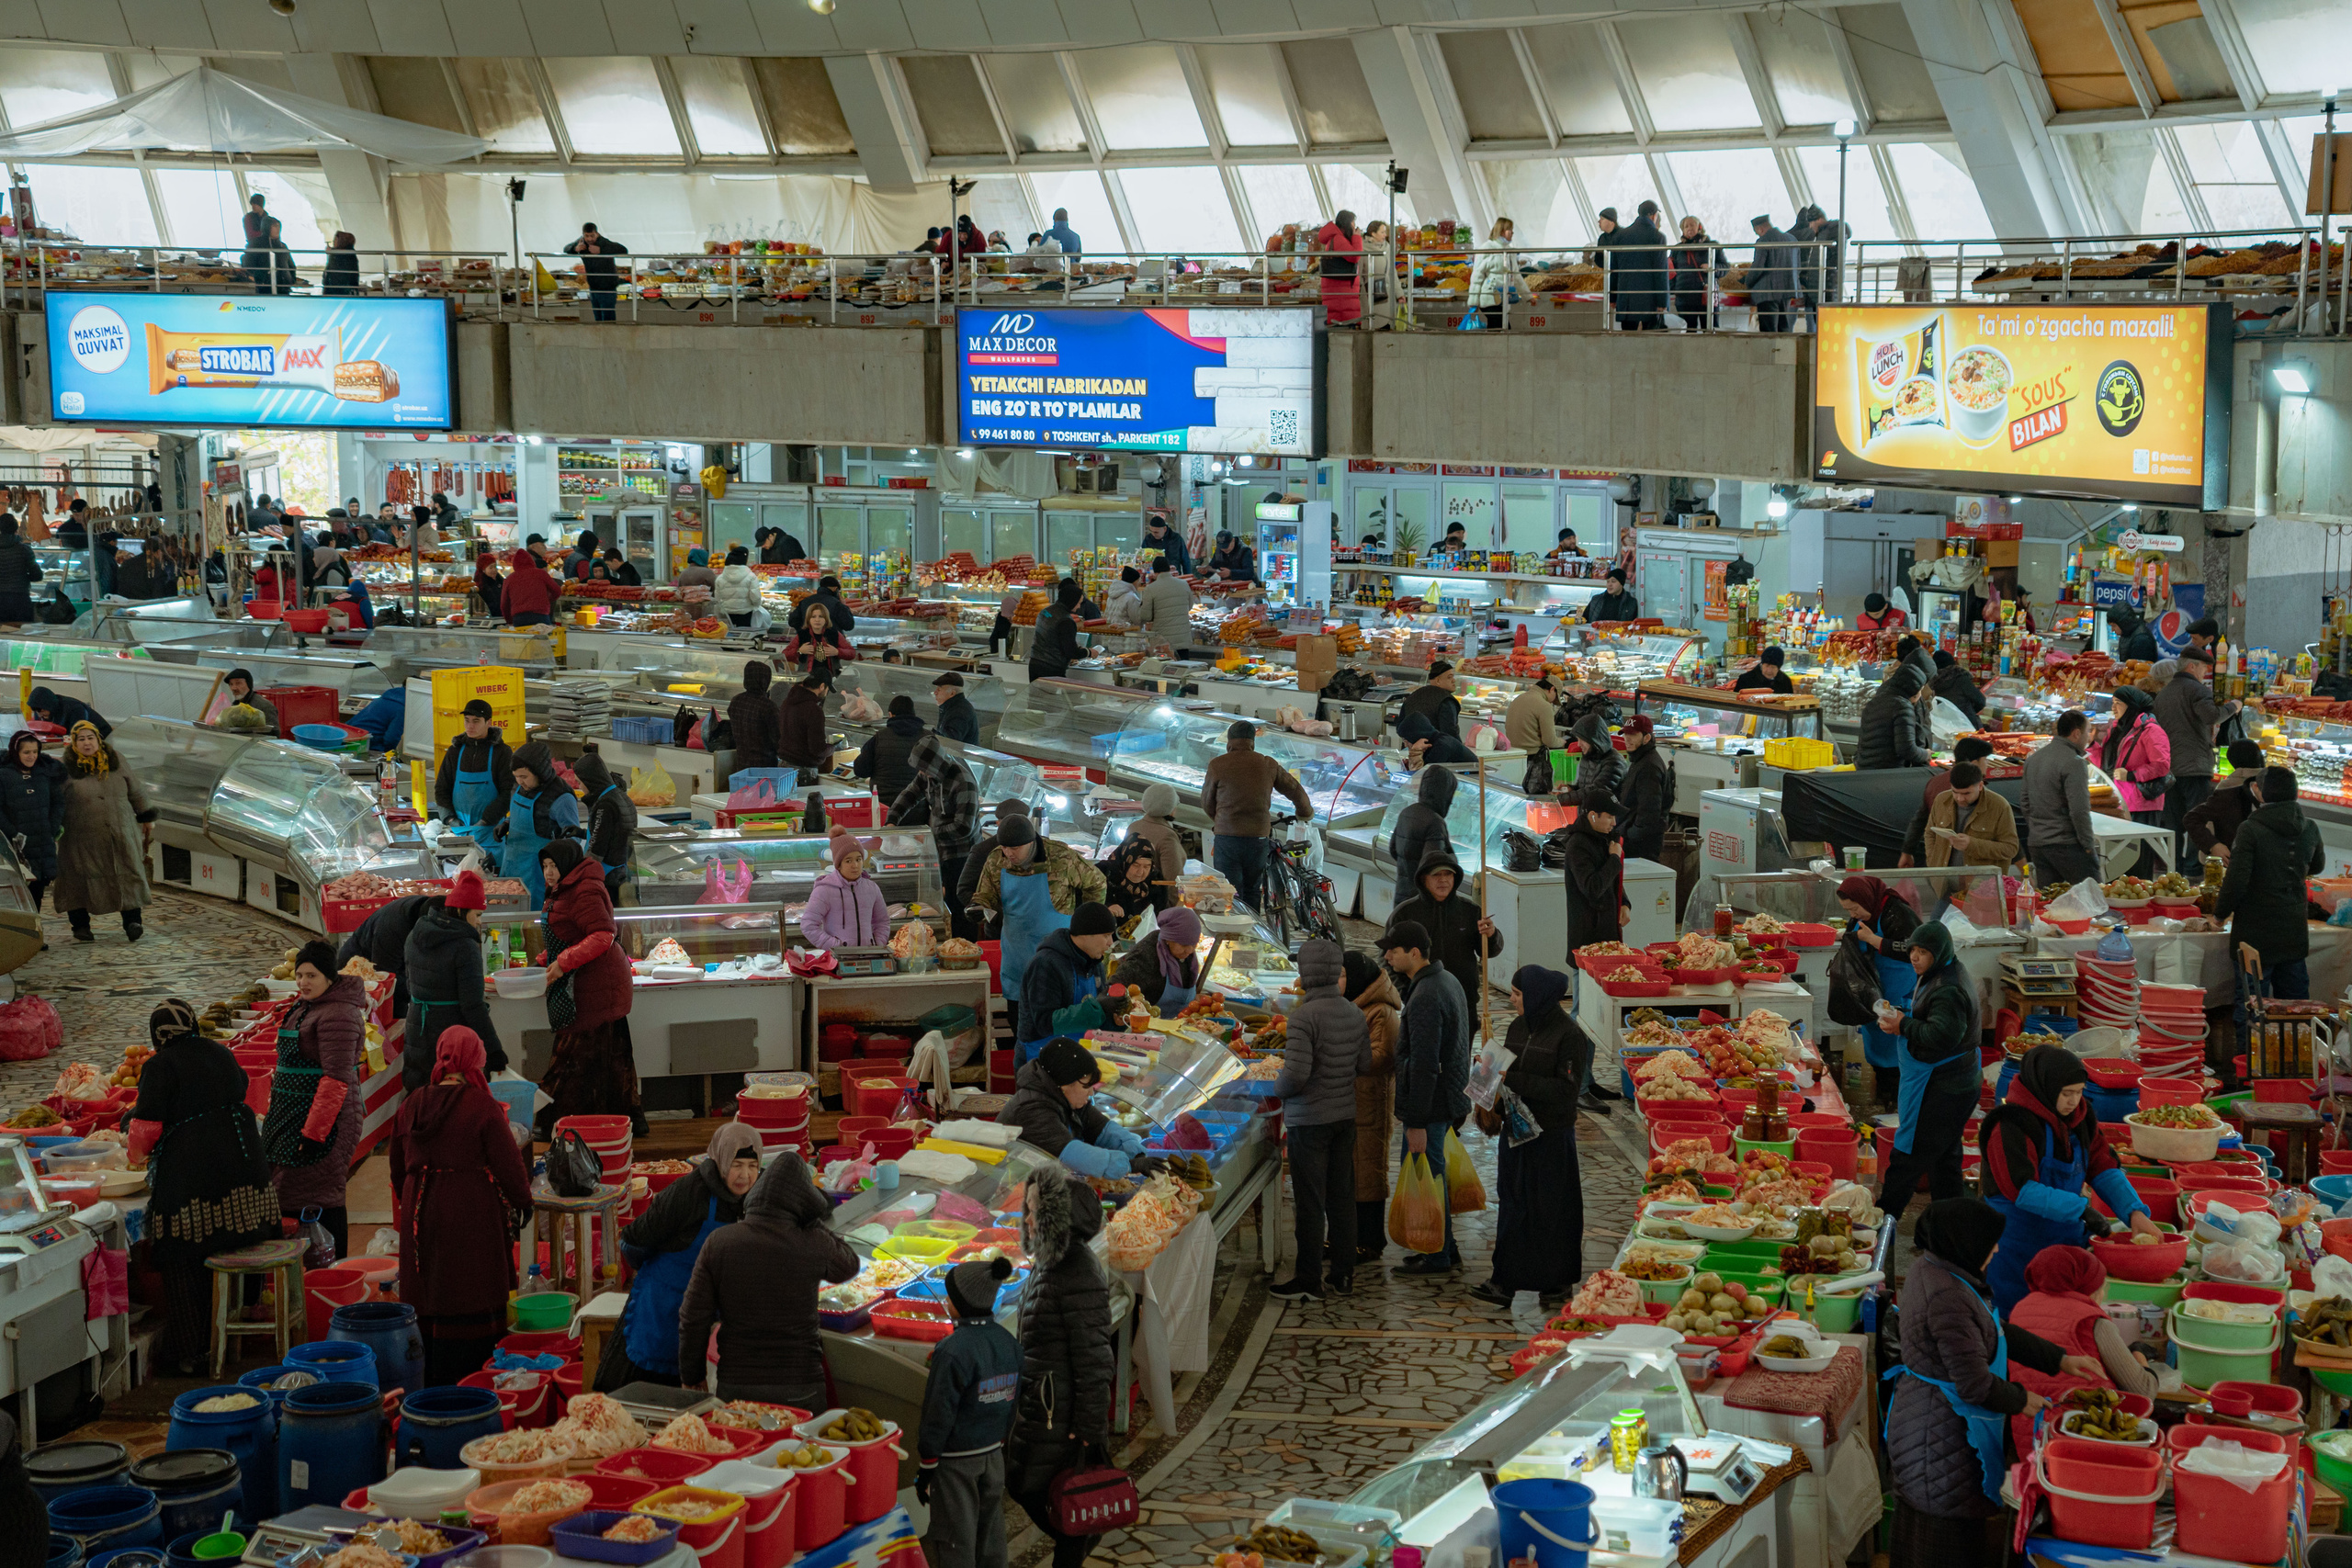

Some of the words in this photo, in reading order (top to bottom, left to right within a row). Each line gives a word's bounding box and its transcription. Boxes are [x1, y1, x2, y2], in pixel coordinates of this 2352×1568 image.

[699, 312, 715, 322] 890
[860, 315, 876, 324] 892
[1529, 316, 1545, 327] 899
[74, 324, 124, 341] MAKSIMAL
[2109, 314, 2174, 338] mazali!
[77, 336, 125, 355] QUVVAT
[968, 337, 1002, 351] MAX
[1005, 337, 1057, 352] DECOR
[1876, 342, 1895, 360] HOT
[202, 349, 273, 372] STROBAR
[282, 344, 327, 372] MAX
[1871, 350, 1904, 379] LUNCH
[970, 377, 1044, 393] YETAKCHI
[1046, 378, 1147, 395] FABRIKADAN
[63, 403, 82, 412] Halal
[971, 400, 1002, 416] ENG
[2012, 405, 2062, 446] BILAN
[978, 429, 990, 439] 99
[992, 429, 1008, 440] 461
[1010, 430, 1022, 440] 80
[1023, 430, 1035, 441] 80
[1052, 431, 1101, 443] TOSHKENT
[1102, 432, 1117, 445] sh.,
[1118, 434, 1160, 444] PARKENT
[1162, 434, 1181, 445] 182
[2096, 586, 2127, 603] pepsi
[476, 683, 508, 694] WIBERG
[202, 864, 213, 879] 81
[260, 882, 269, 897] 80
[1096, 1032, 1151, 1043] BAZAR
[1070, 1498, 1131, 1523] JORDAN
